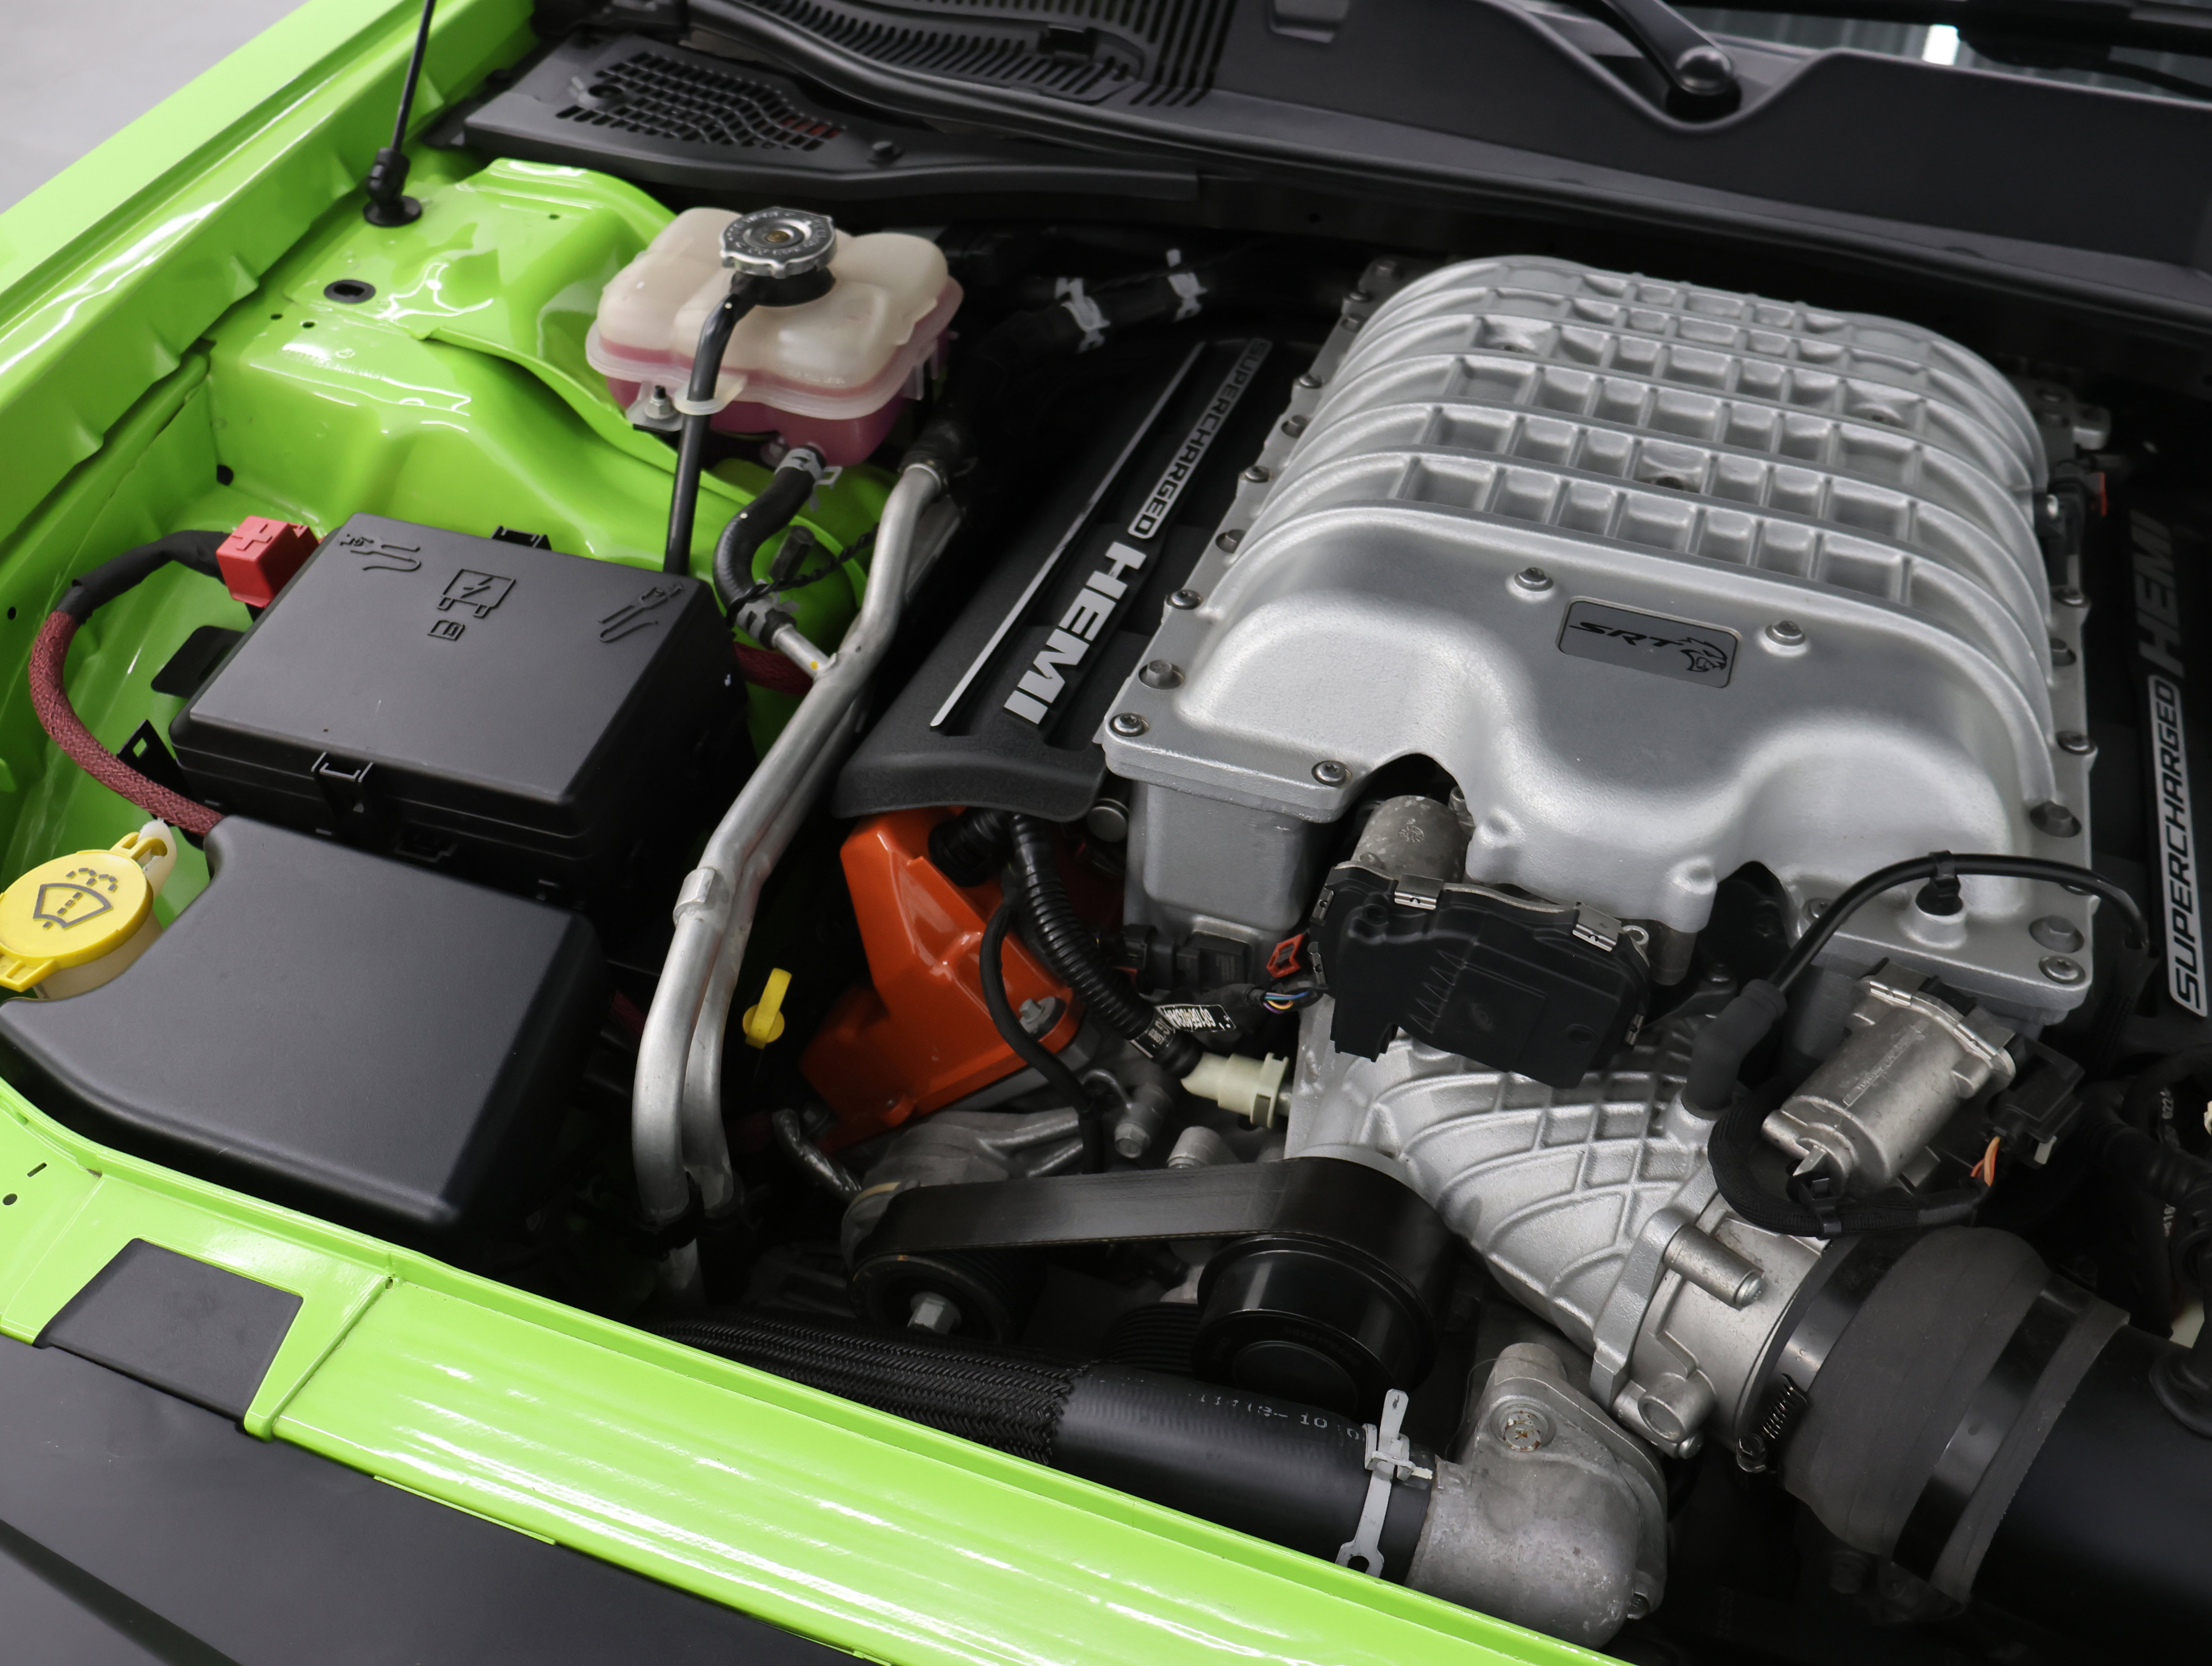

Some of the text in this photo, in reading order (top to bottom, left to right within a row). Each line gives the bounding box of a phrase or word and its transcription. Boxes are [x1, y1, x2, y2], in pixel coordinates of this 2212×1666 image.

[1132, 339, 1269, 533] SUPERCHARGED
[1003, 541, 1147, 725] HEMI
[1569, 621, 1686, 646] SRT
[2129, 509, 2186, 680] HEMI
[2155, 686, 2202, 1010] SUPERCHARGED
